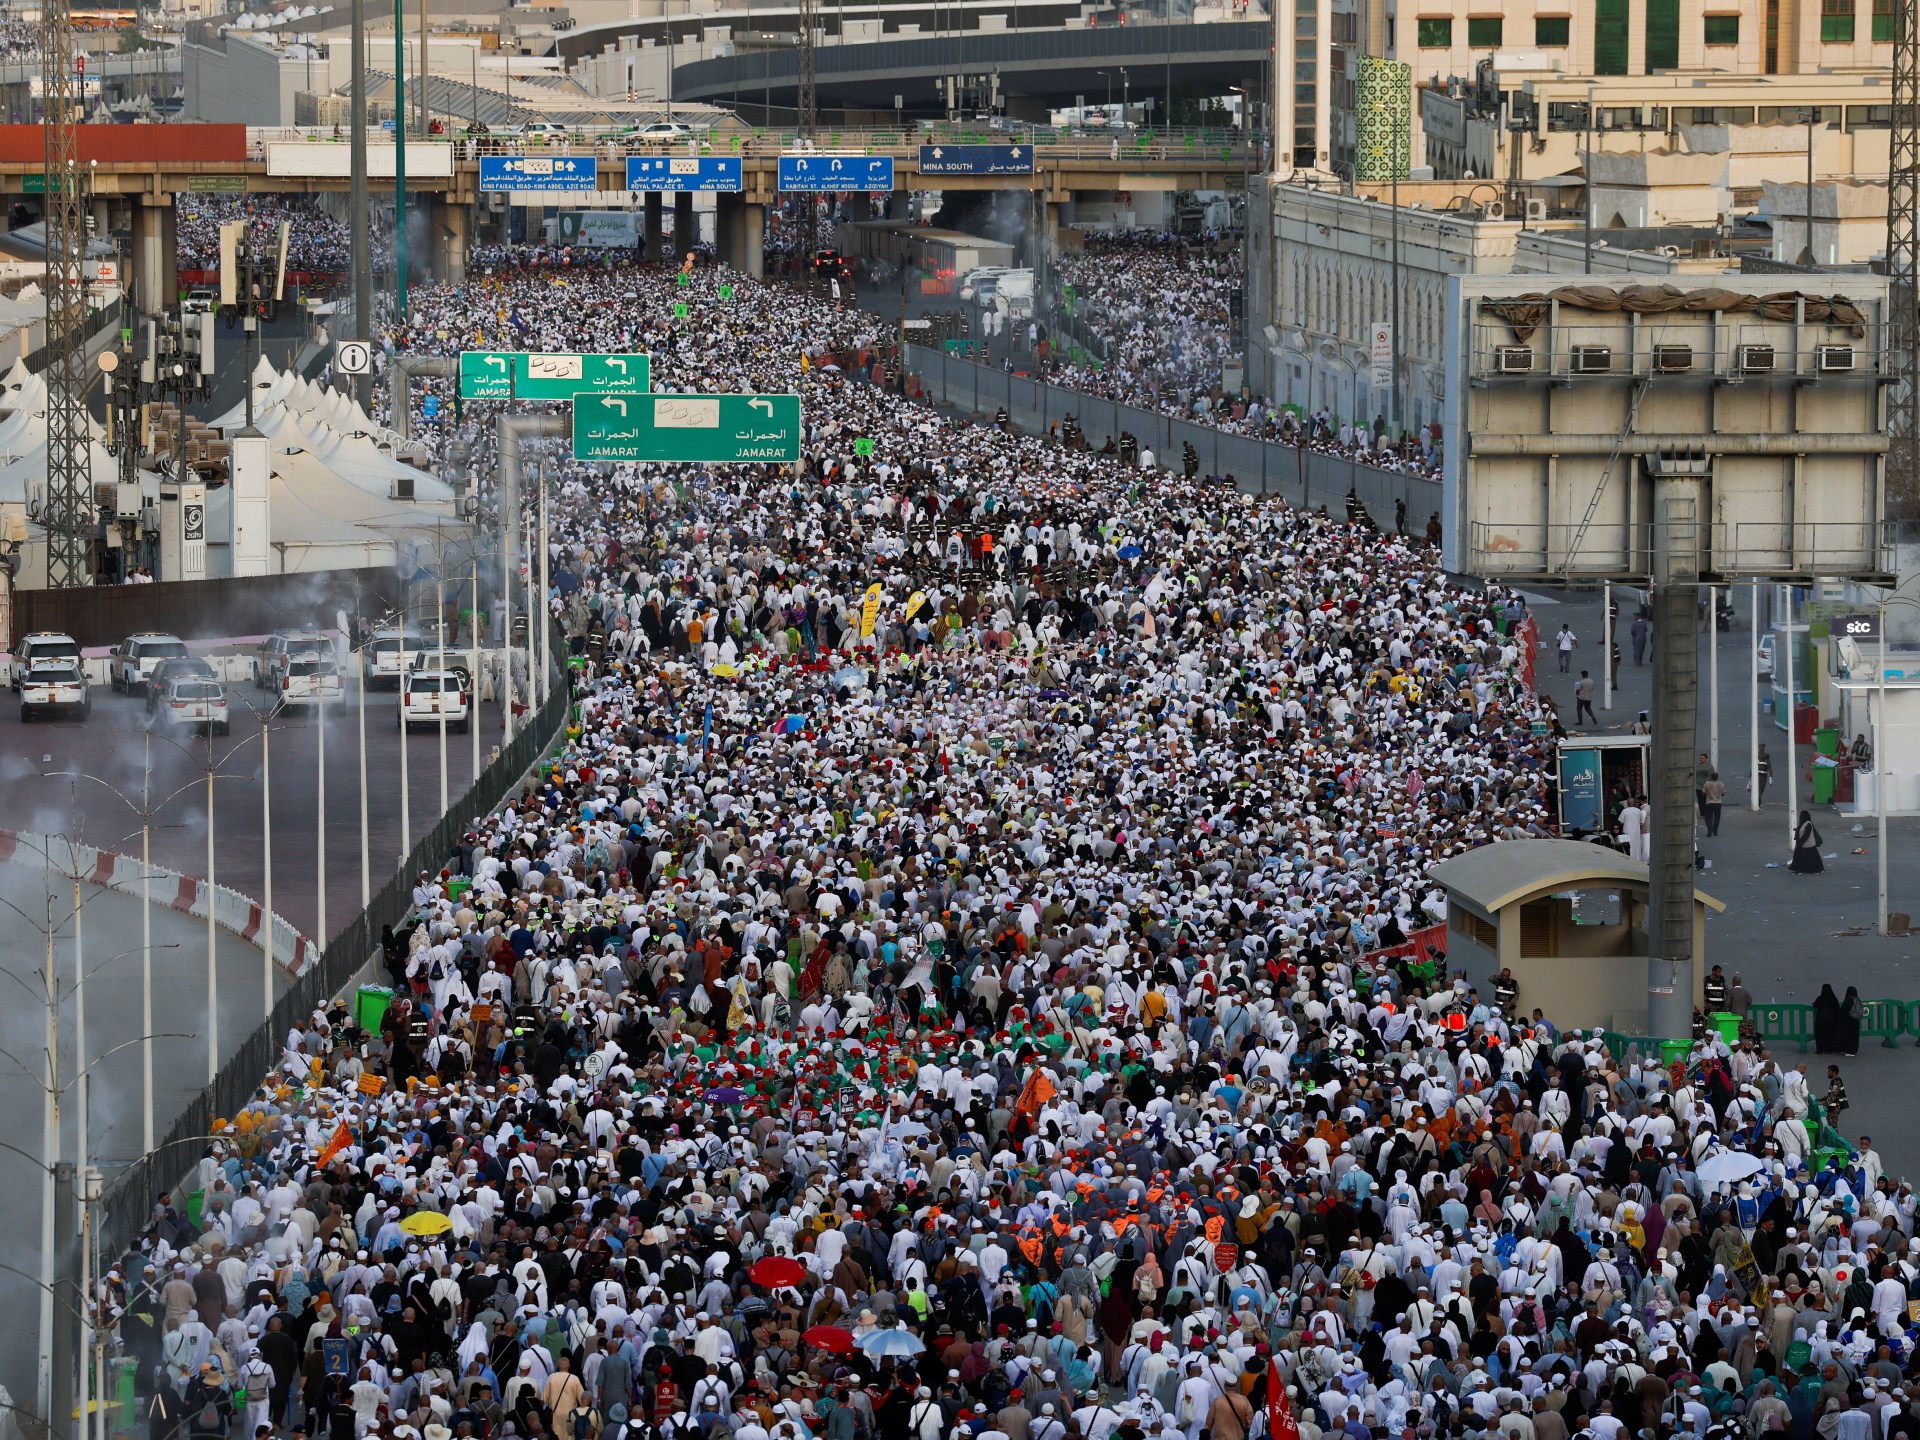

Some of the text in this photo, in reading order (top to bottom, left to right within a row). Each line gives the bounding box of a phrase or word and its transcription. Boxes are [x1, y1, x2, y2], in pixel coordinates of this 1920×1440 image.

[1006, 163, 1031, 172] جنوب
[474, 374, 516, 387] اجمرات
[592, 376, 636, 387] الجمرات
[474, 388, 516, 397] JAMARA
[587, 427, 639, 441] الجمرات
[735, 428, 787, 442] الجمرات
[587, 447, 639, 457] JAMARAT
[735, 448, 787, 458] JAMARAT
[1846, 620, 1871, 634] stc
[331, 1354, 342, 1371] 2
